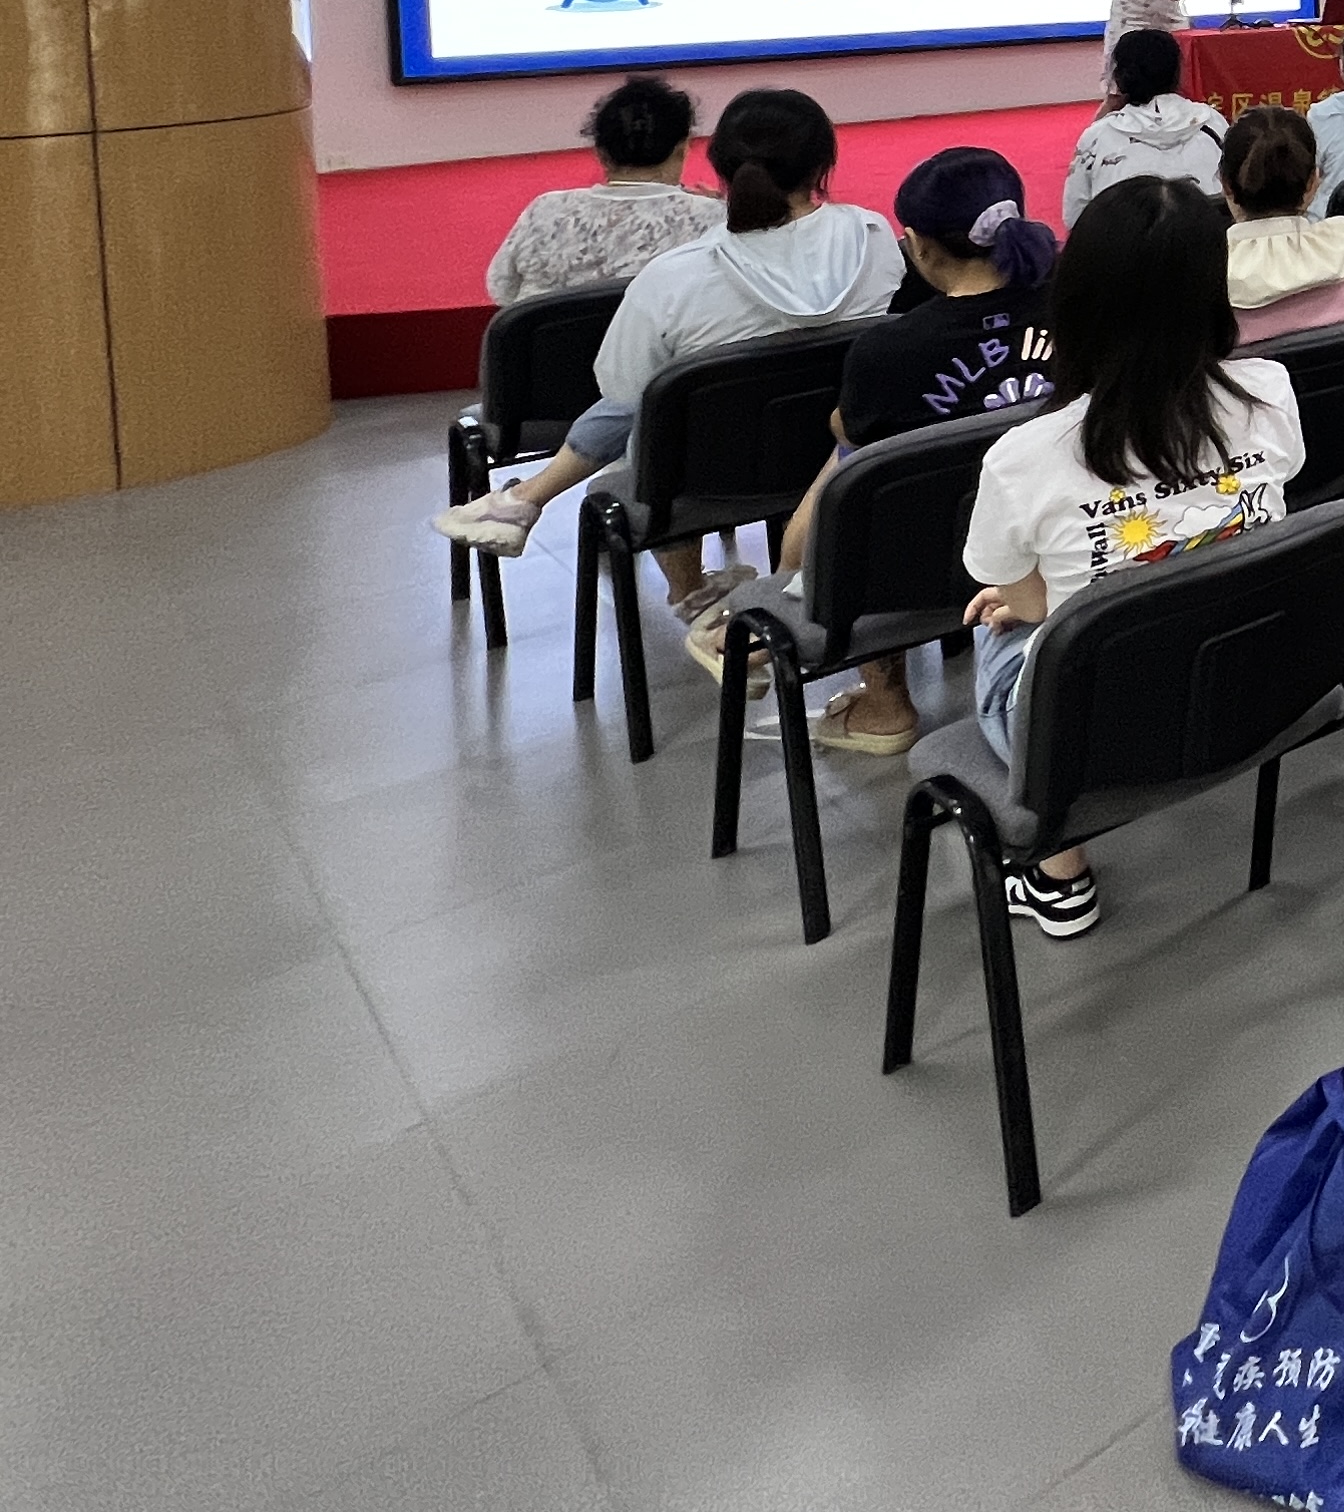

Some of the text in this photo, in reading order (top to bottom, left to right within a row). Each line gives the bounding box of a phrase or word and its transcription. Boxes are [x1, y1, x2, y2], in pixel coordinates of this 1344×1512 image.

[922, 338, 1010, 415] MLB
[1080, 490, 1148, 520] Vans
[1228, 451, 1267, 475] Six
